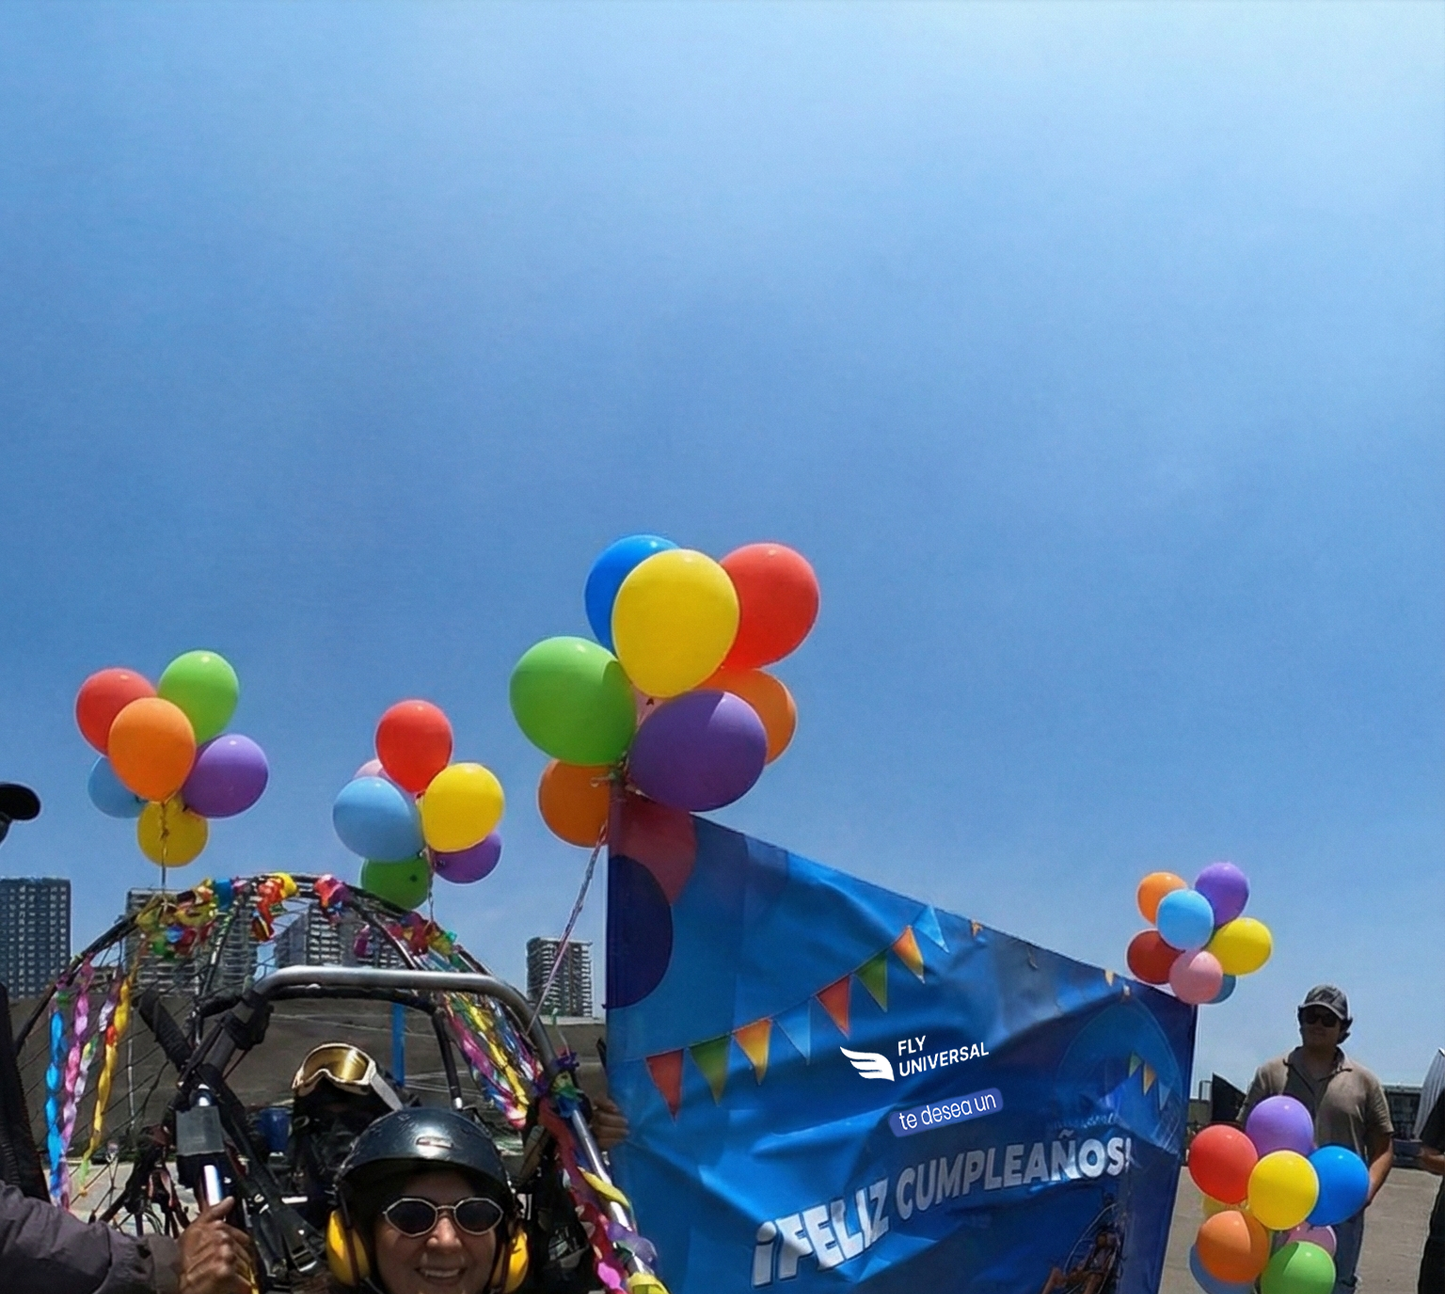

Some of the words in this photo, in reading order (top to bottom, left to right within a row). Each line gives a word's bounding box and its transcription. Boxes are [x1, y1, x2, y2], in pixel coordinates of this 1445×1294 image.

[897, 1035, 926, 1057] FLY
[898, 1041, 990, 1077] UNIVERSAL
[898, 1112, 918, 1131] te
[920, 1099, 973, 1126] desea
[974, 1093, 998, 1113] un
[752, 1176, 891, 1287] ¡FELIZ
[895, 1128, 1132, 1220] CUMPLEAÑOS!
